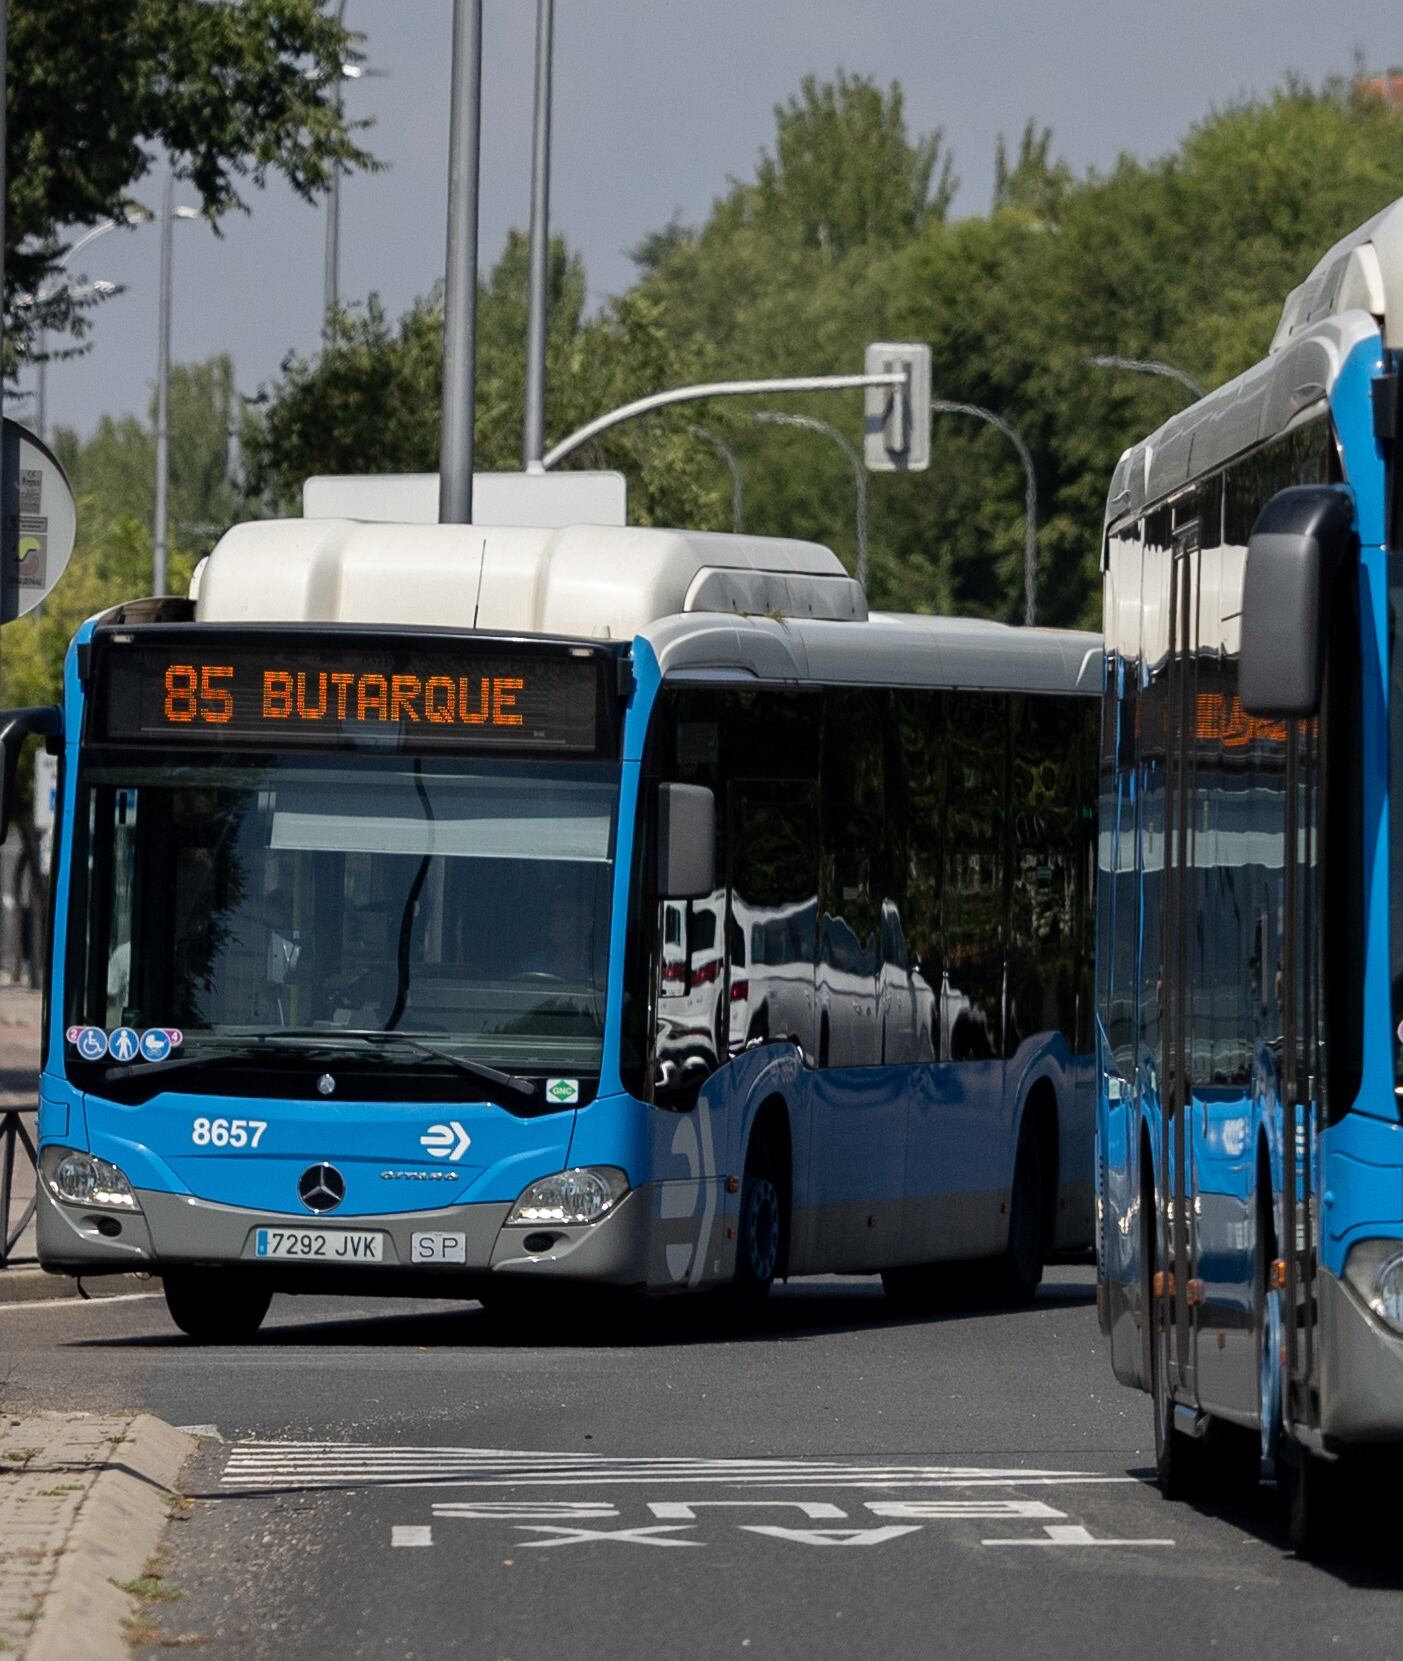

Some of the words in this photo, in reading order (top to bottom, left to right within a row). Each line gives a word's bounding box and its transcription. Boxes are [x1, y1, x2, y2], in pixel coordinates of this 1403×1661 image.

[164, 665, 233, 723] 85
[263, 670, 524, 726] BUTARQUE
[552, 1087, 572, 1095] GNC
[192, 1117, 267, 1148] 8657
[272, 1233, 326, 1256] 7292
[335, 1235, 376, 1258] JVK
[431, 1501, 1069, 1518] BUS
[391, 1524, 1176, 1547] TAXI
